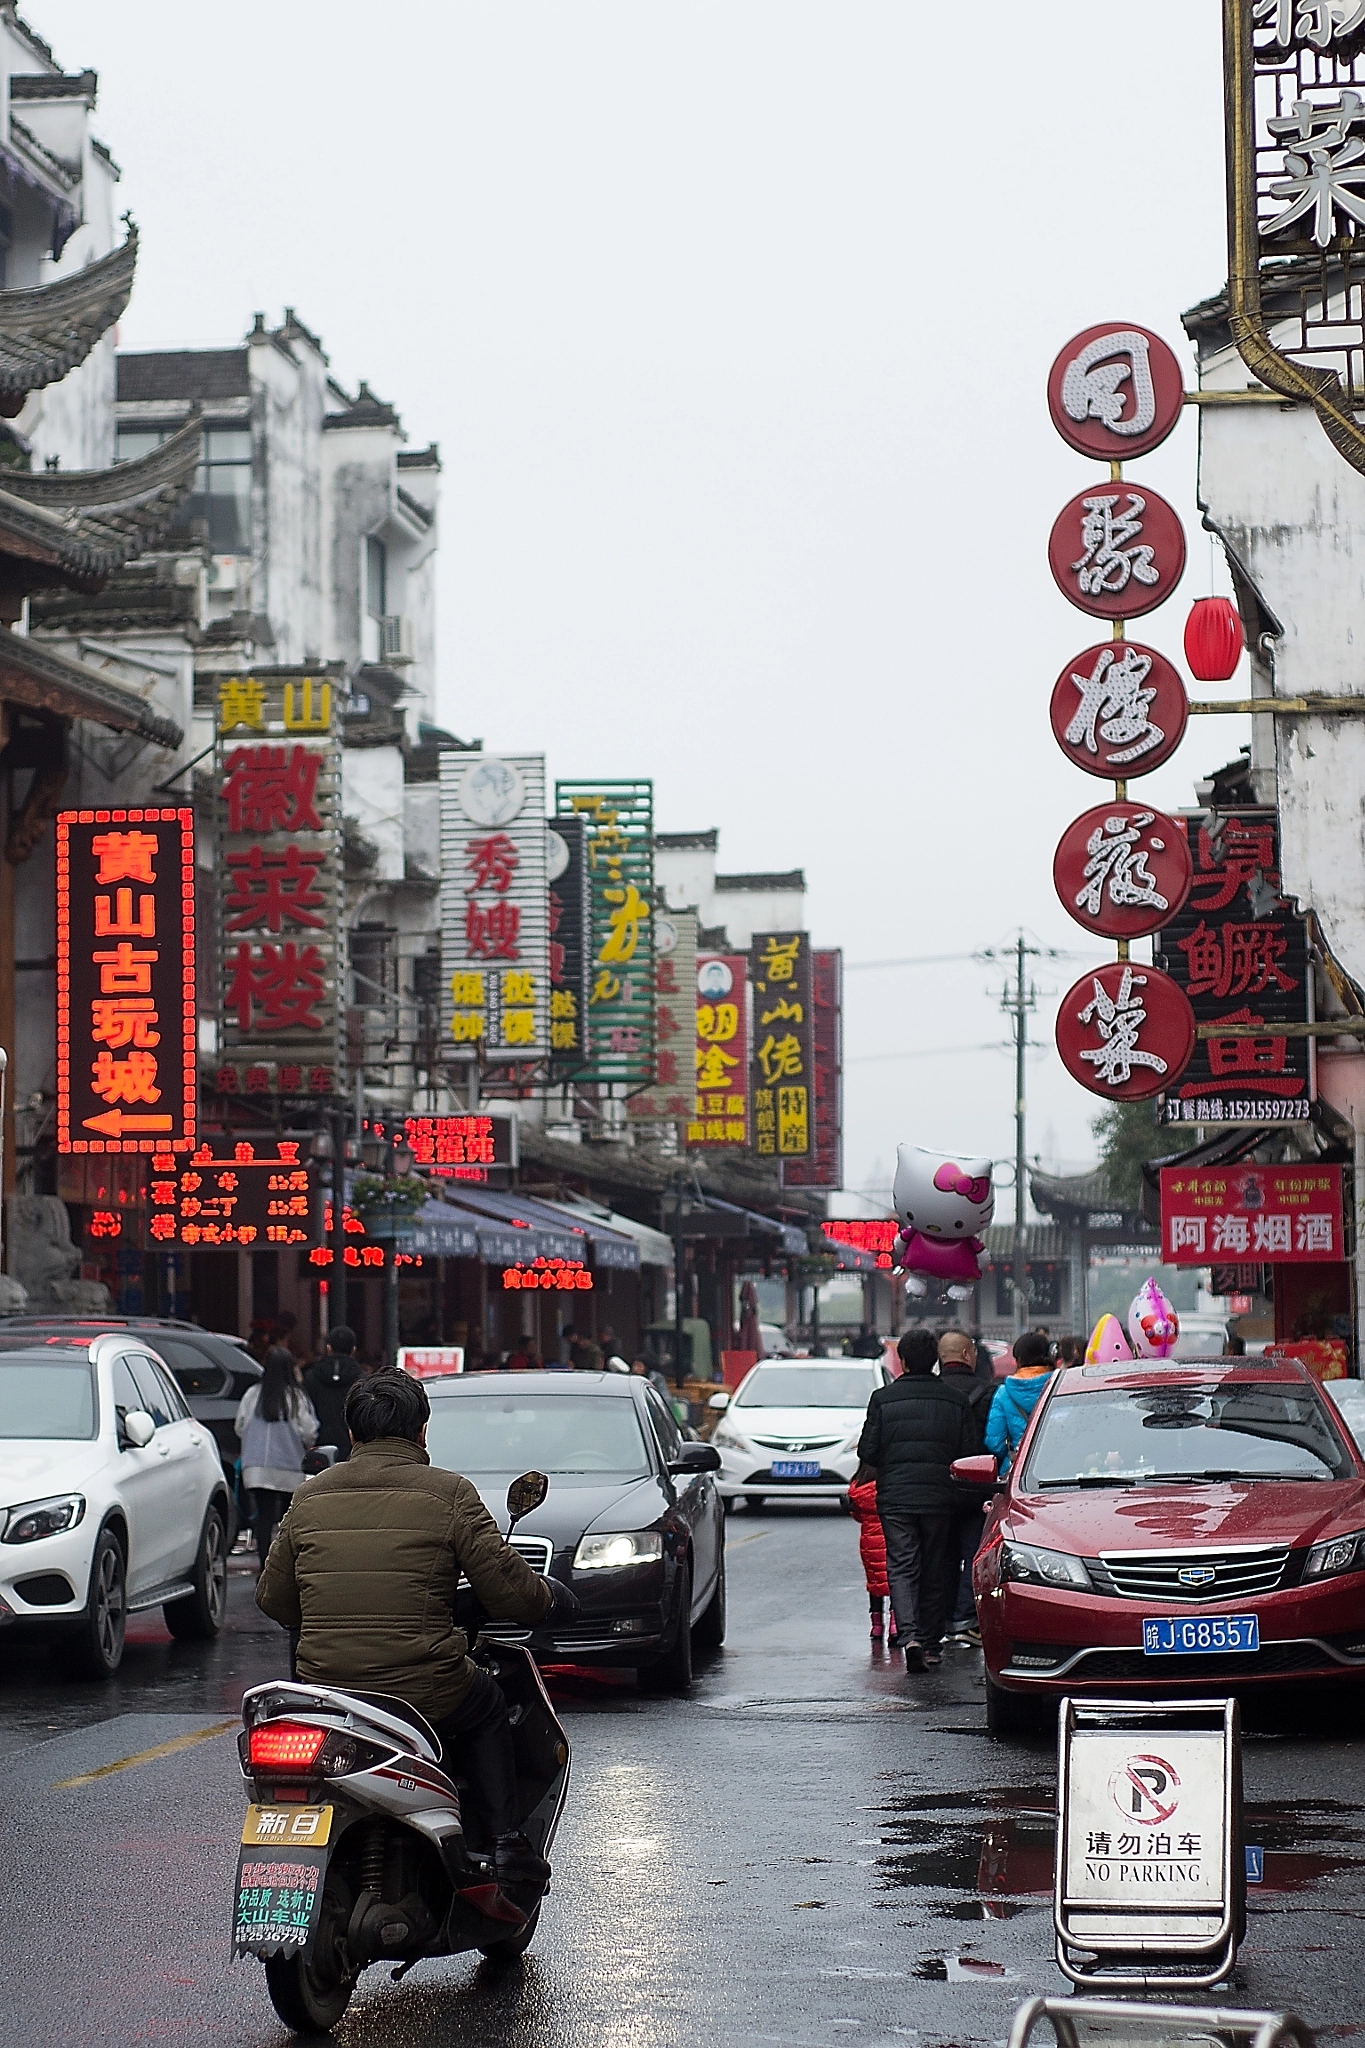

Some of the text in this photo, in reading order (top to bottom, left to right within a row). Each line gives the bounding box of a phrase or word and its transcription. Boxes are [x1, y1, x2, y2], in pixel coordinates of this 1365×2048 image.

[218, 677, 331, 732] 黄山
[220, 743, 327, 1033] 徽菜楼
[464, 833, 521, 961] 秀嫂
[91, 831, 161, 1106] 黄山古玩城
[756, 937, 803, 1085] 黄山佬
[214, 1066, 333, 1094] 免费停车
[755, 1088, 775, 1153] 旗舰店
[1168, 1098, 1310, 1120] 订餐热线:15215597273
[1171, 1213, 1333, 1253] 阿海烟酒
[503, 1268, 593, 1289] 黄山小笼包
[255, 1812, 320, 1835] 新日
[1086, 1832, 1203, 1855] 请勿泊车
[242, 1862, 319, 1879] 同步变频动力
[1085, 1864, 1201, 1882] NO PARKING
[238, 1888, 315, 1911] 好品质 选新日
[236, 1908, 310, 1927] 大山车业
